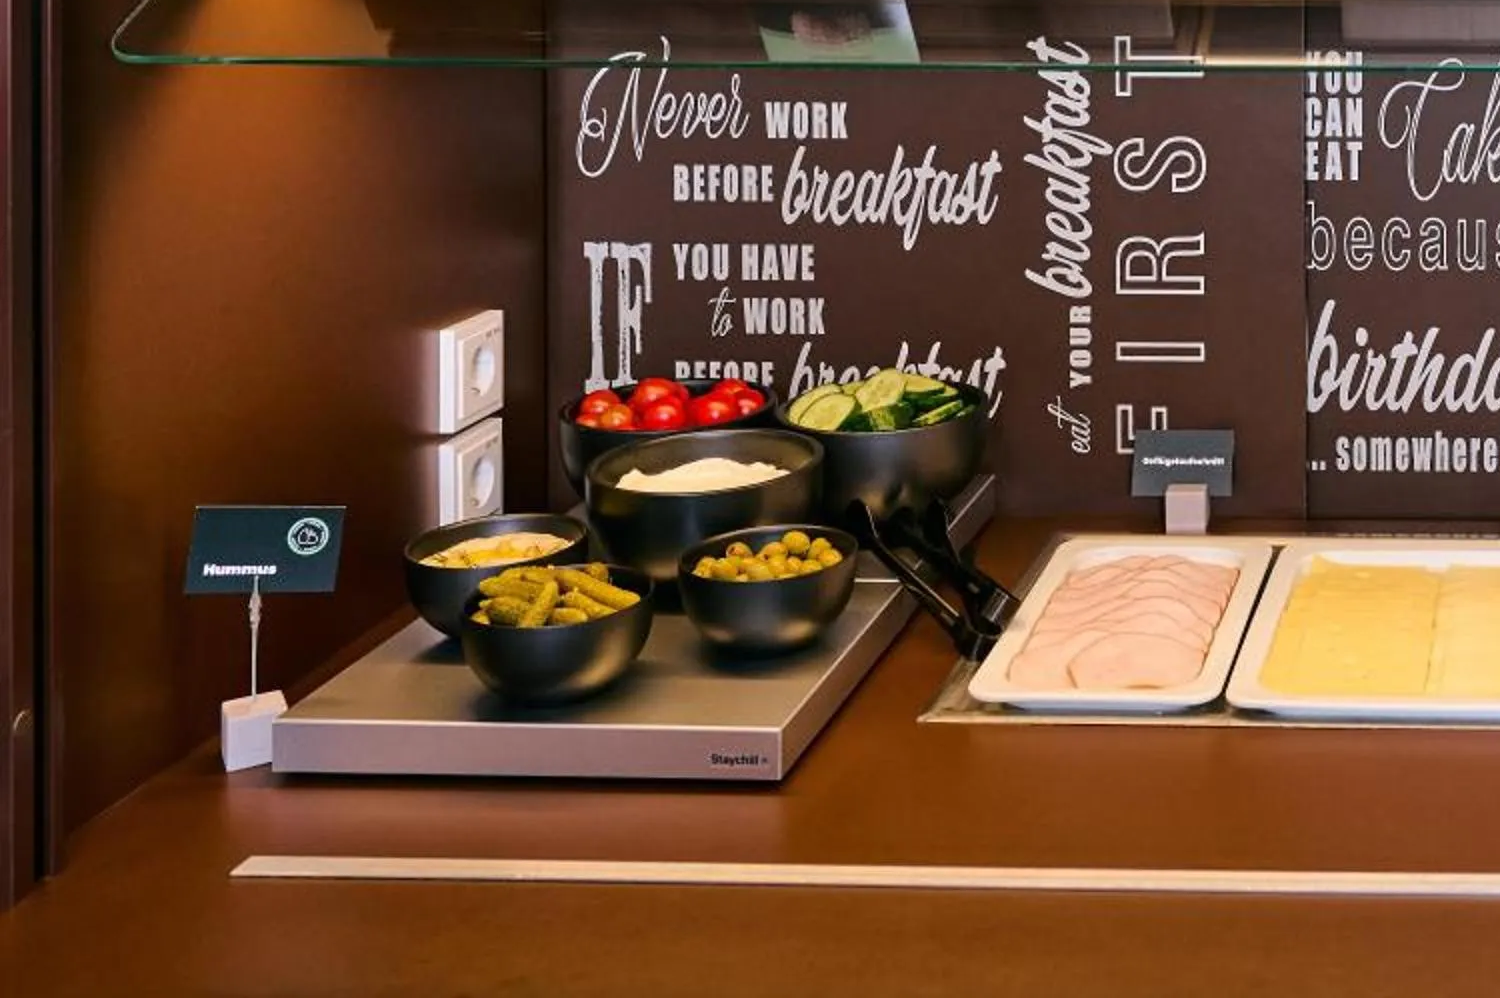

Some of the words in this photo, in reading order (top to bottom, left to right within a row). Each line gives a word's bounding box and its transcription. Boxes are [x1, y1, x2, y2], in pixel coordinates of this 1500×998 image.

[1306, 51, 1363, 94] YOU
[576, 35, 750, 177] Never
[765, 102, 849, 139] WORK
[1306, 97, 1363, 138] CAN
[1024, 37, 1114, 299] breakfast
[1306, 140, 1363, 181] EAT
[674, 164, 774, 202] BEFORE
[780, 145, 1003, 251] breakfast
[673, 243, 729, 281] YOU
[741, 243, 815, 281] HAVE
[584, 241, 653, 393] IF
[708, 286, 737, 337] to
[743, 297, 825, 335] WORK
[1069, 305, 1093, 389] YOUR
[1047, 396, 1092, 454] eat
[1335, 430, 1498, 473] somewhere
[203, 563, 277, 576] Hummus
